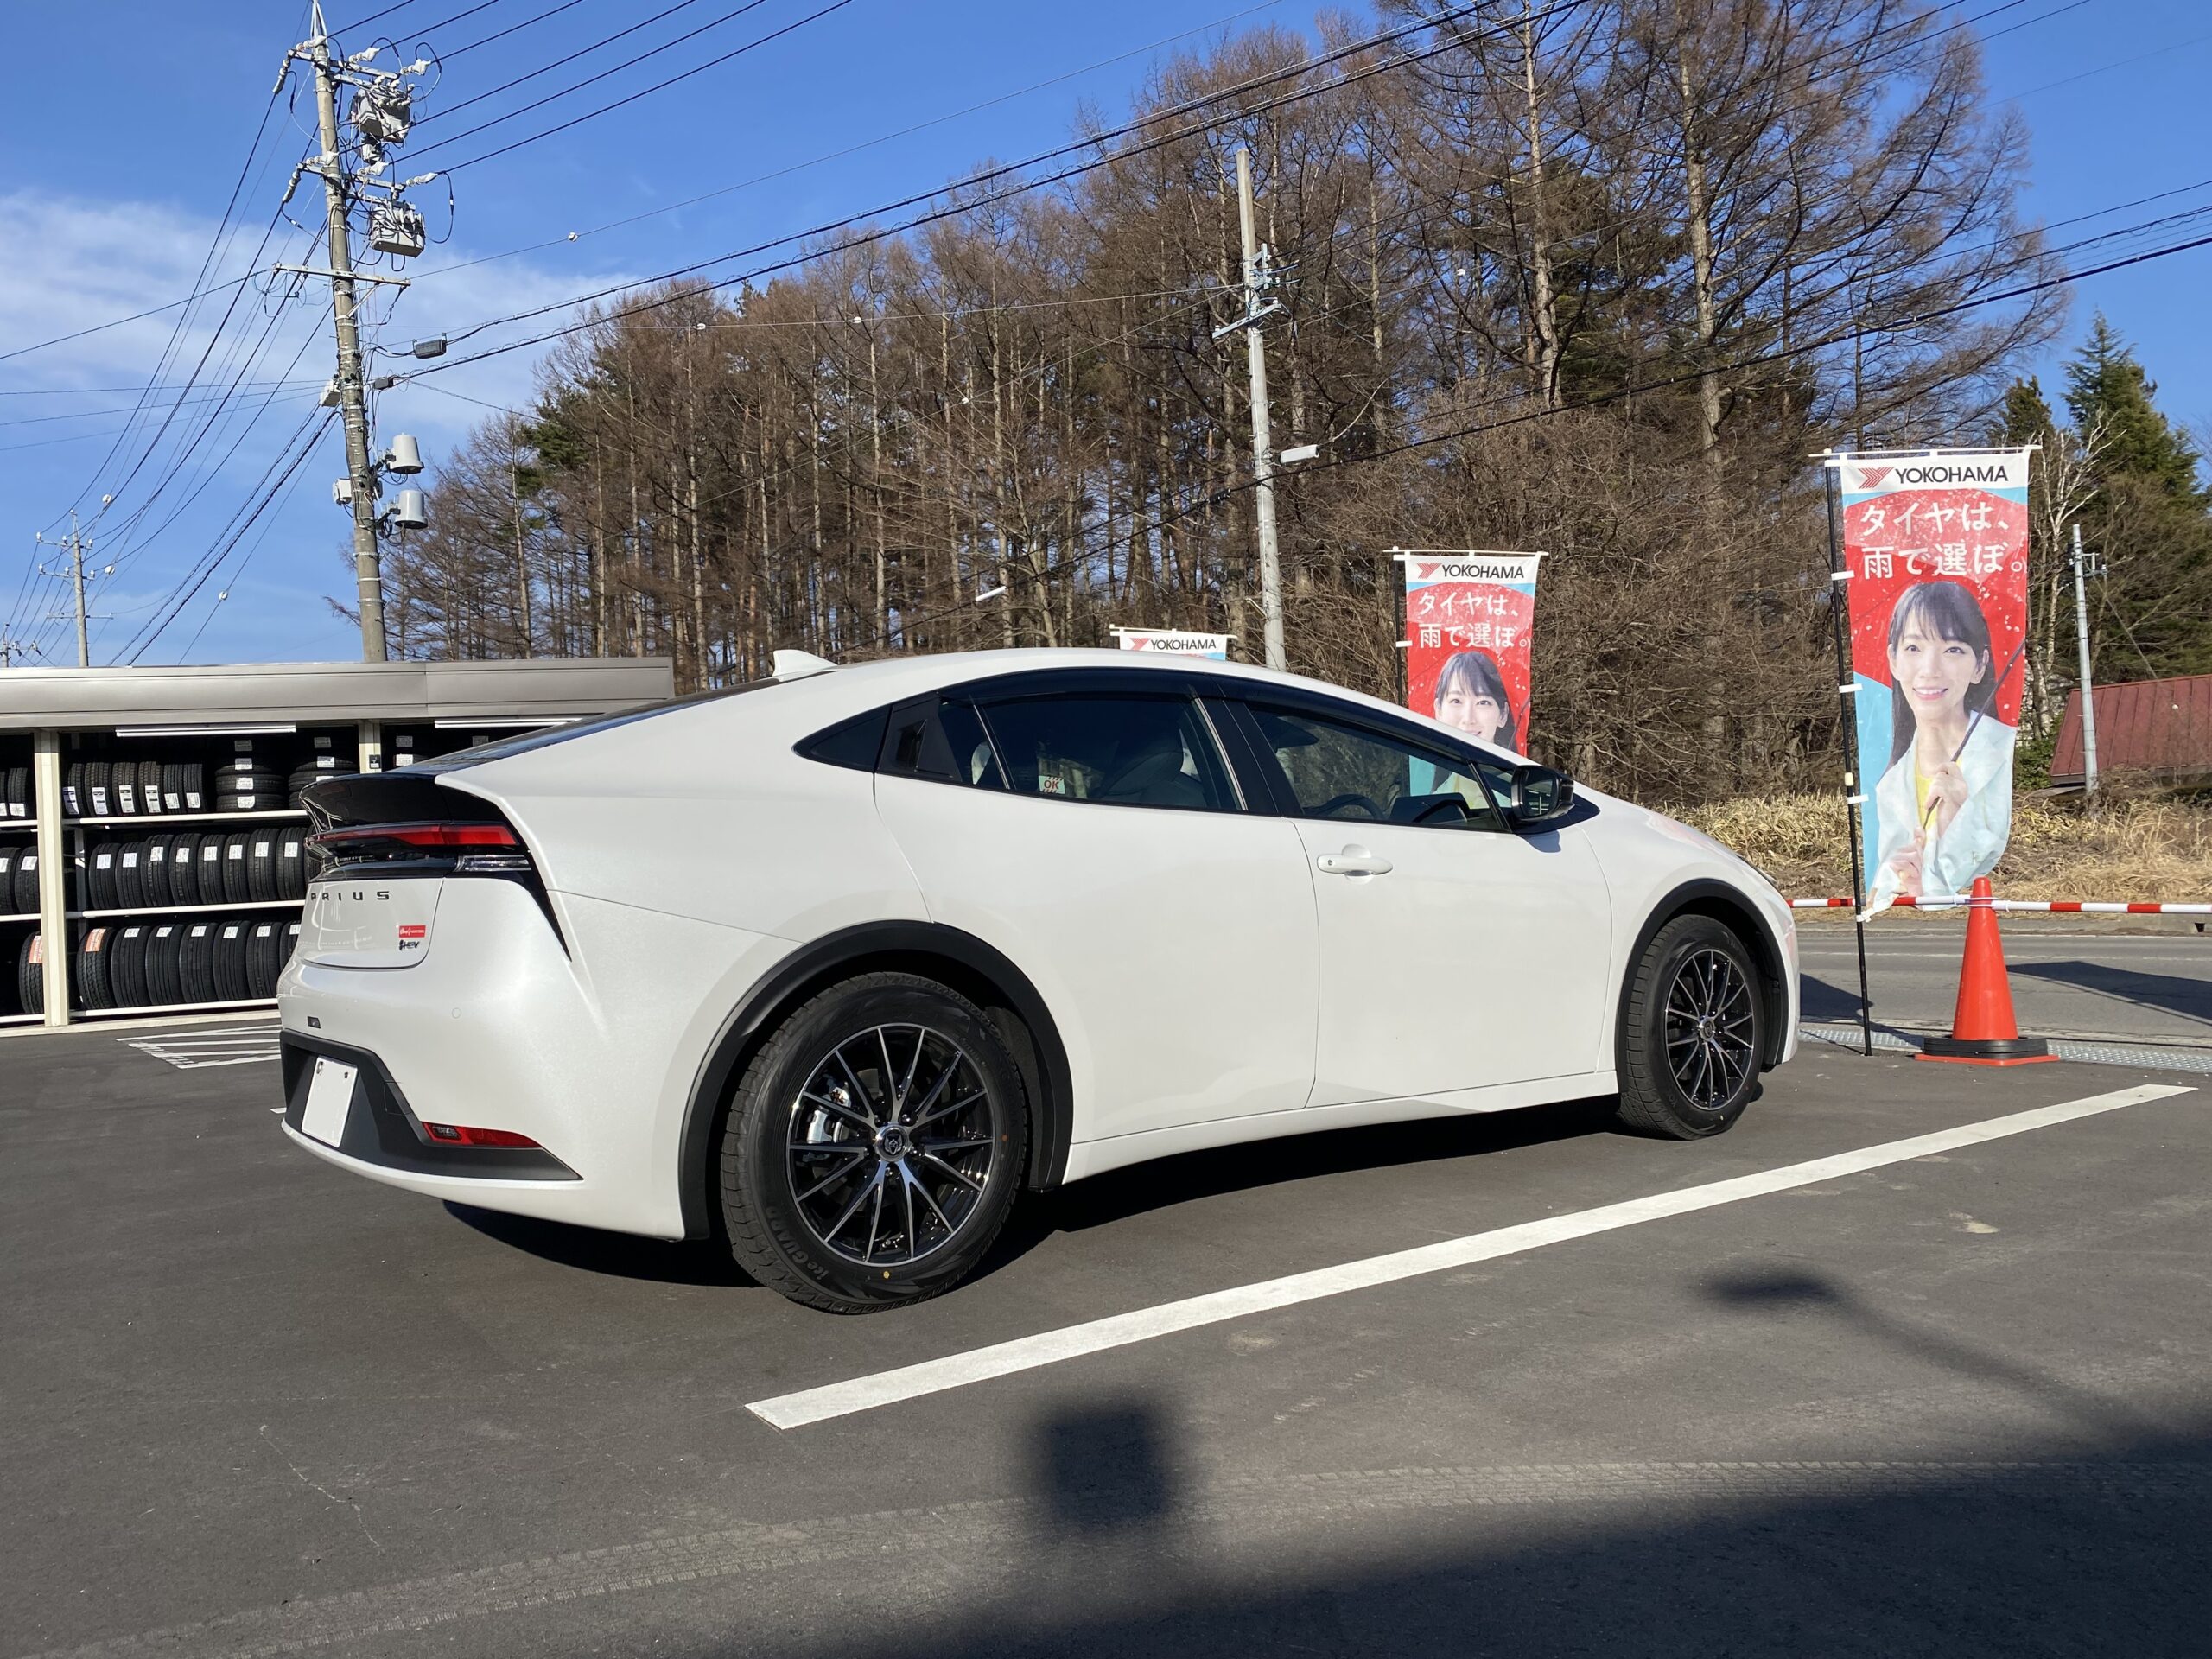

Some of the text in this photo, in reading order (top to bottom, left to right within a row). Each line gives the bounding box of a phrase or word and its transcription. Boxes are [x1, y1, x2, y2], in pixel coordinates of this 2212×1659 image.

[1895, 465, 2009, 484] YOKOHAMA
[1860, 501, 2010, 537] タイヤは、
[1861, 542, 2024, 580] 雨で選ぼ。
[1441, 563, 1524, 579] YOKOHAMA
[1418, 591, 1519, 617] タイヤは、
[1150, 639, 1217, 650] YOKOHAMA
[1418, 623, 1528, 649] 雨で選ぼ。
[1044, 780, 1059, 790] OK
[310, 891, 390, 901] PRIUS
